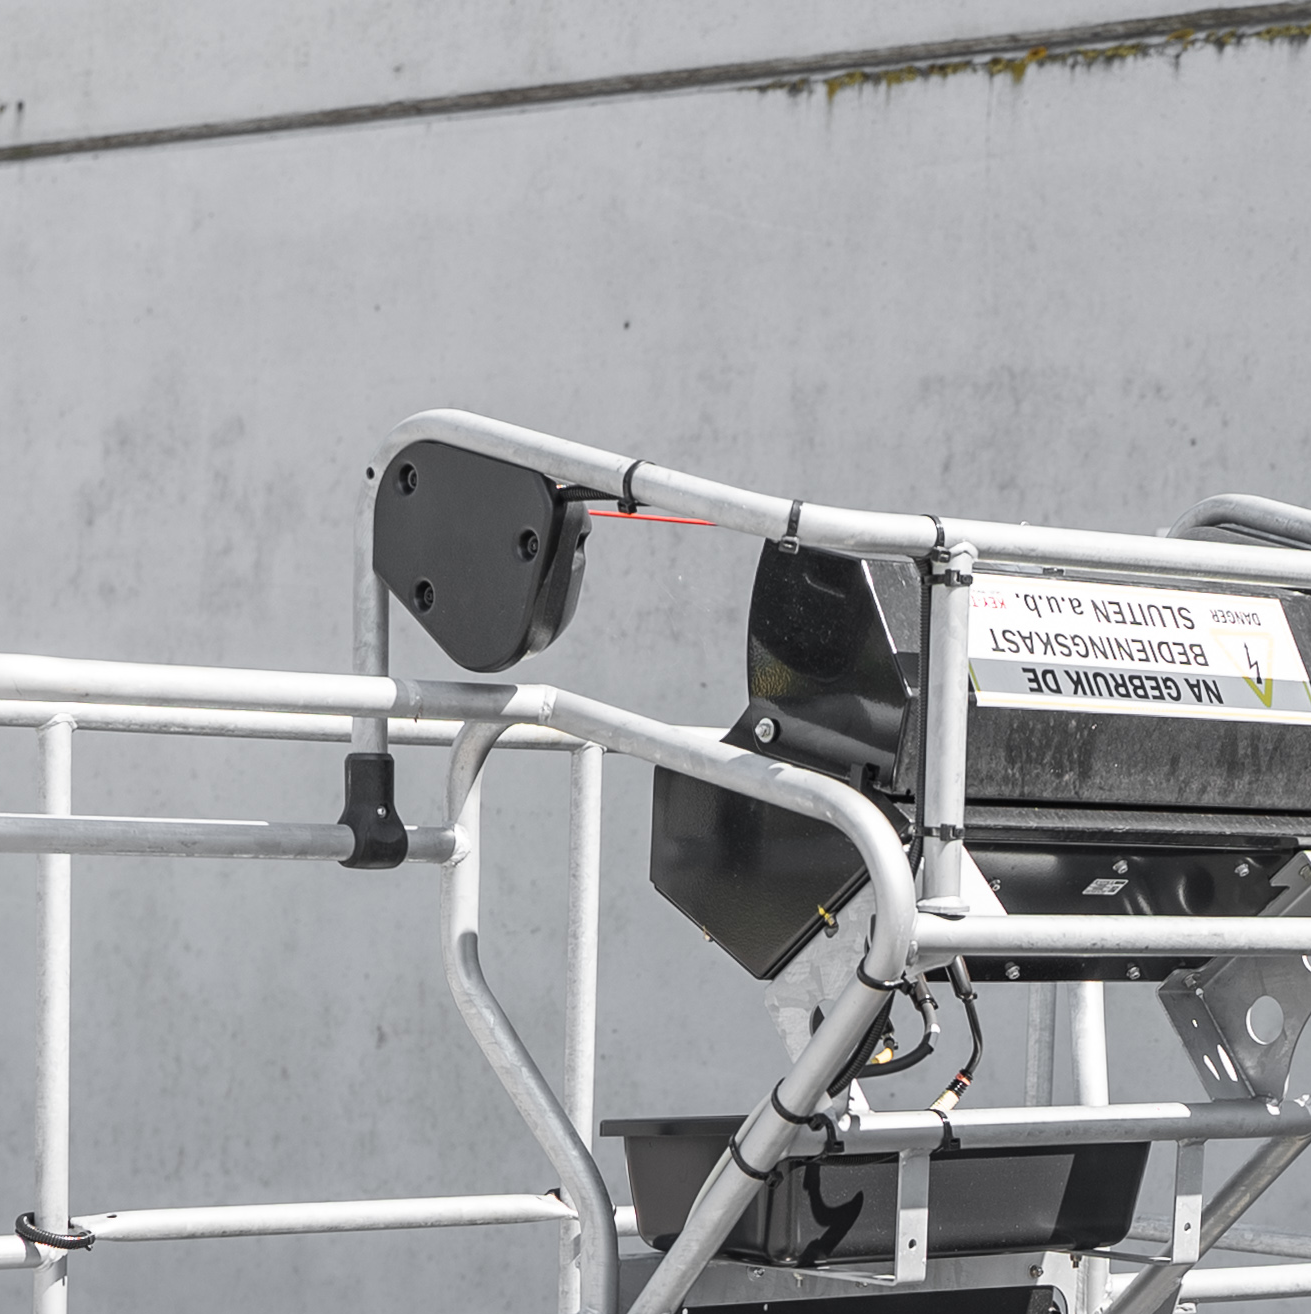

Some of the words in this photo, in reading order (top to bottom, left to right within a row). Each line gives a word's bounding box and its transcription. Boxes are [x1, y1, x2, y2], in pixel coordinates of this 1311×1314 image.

[1015, 593, 1084, 618] a.u.b.
[1090, 599, 1195, 630] SLUITEN
[1209, 609, 1262, 626] DANGER
[989, 628, 1210, 667] BEDIENINGSKAST
[1021, 667, 1063, 695] DE
[1064, 670, 1182, 702] GEBRUIK
[1184, 677, 1224, 704] NA
